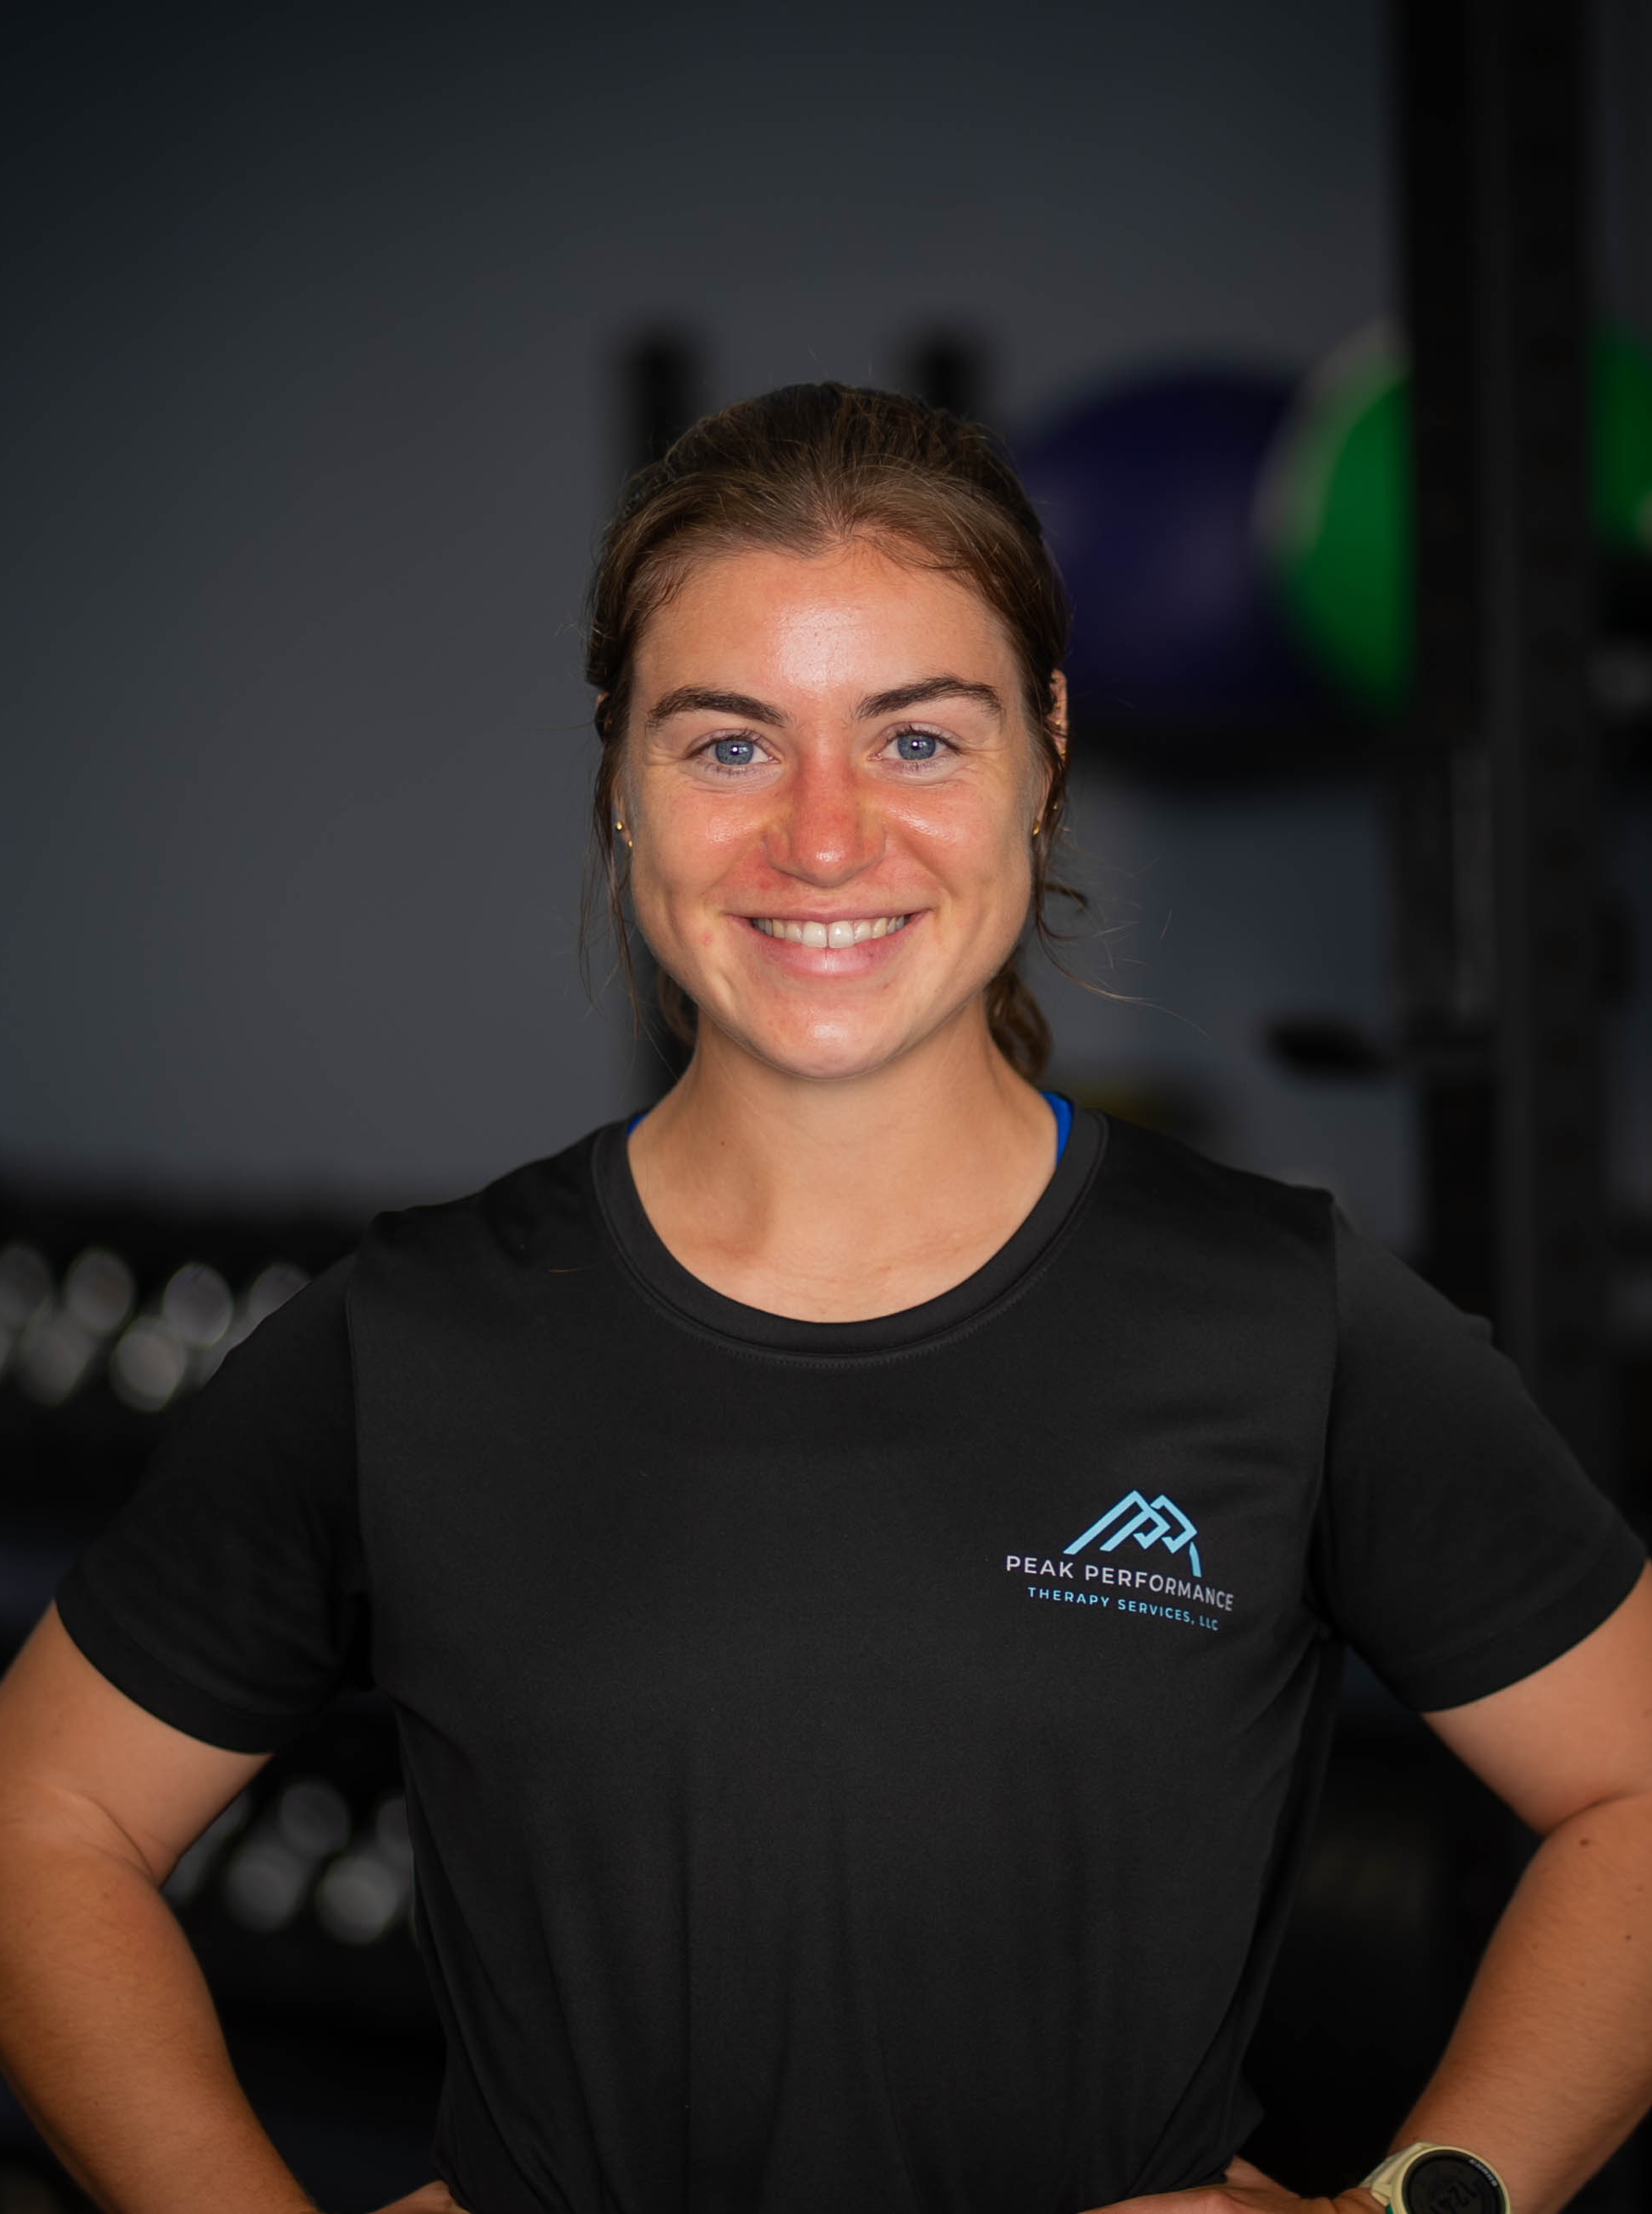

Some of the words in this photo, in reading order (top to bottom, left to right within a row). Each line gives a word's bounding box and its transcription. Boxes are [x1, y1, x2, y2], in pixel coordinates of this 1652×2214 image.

[1006, 1555, 1074, 1579] PEAK
[1085, 1564, 1234, 1611] PERFORMANCE
[1027, 1586, 1110, 1608] THERAPY
[1117, 1599, 1195, 1625] SERVICES,
[1199, 1615, 1219, 1631] LLC
